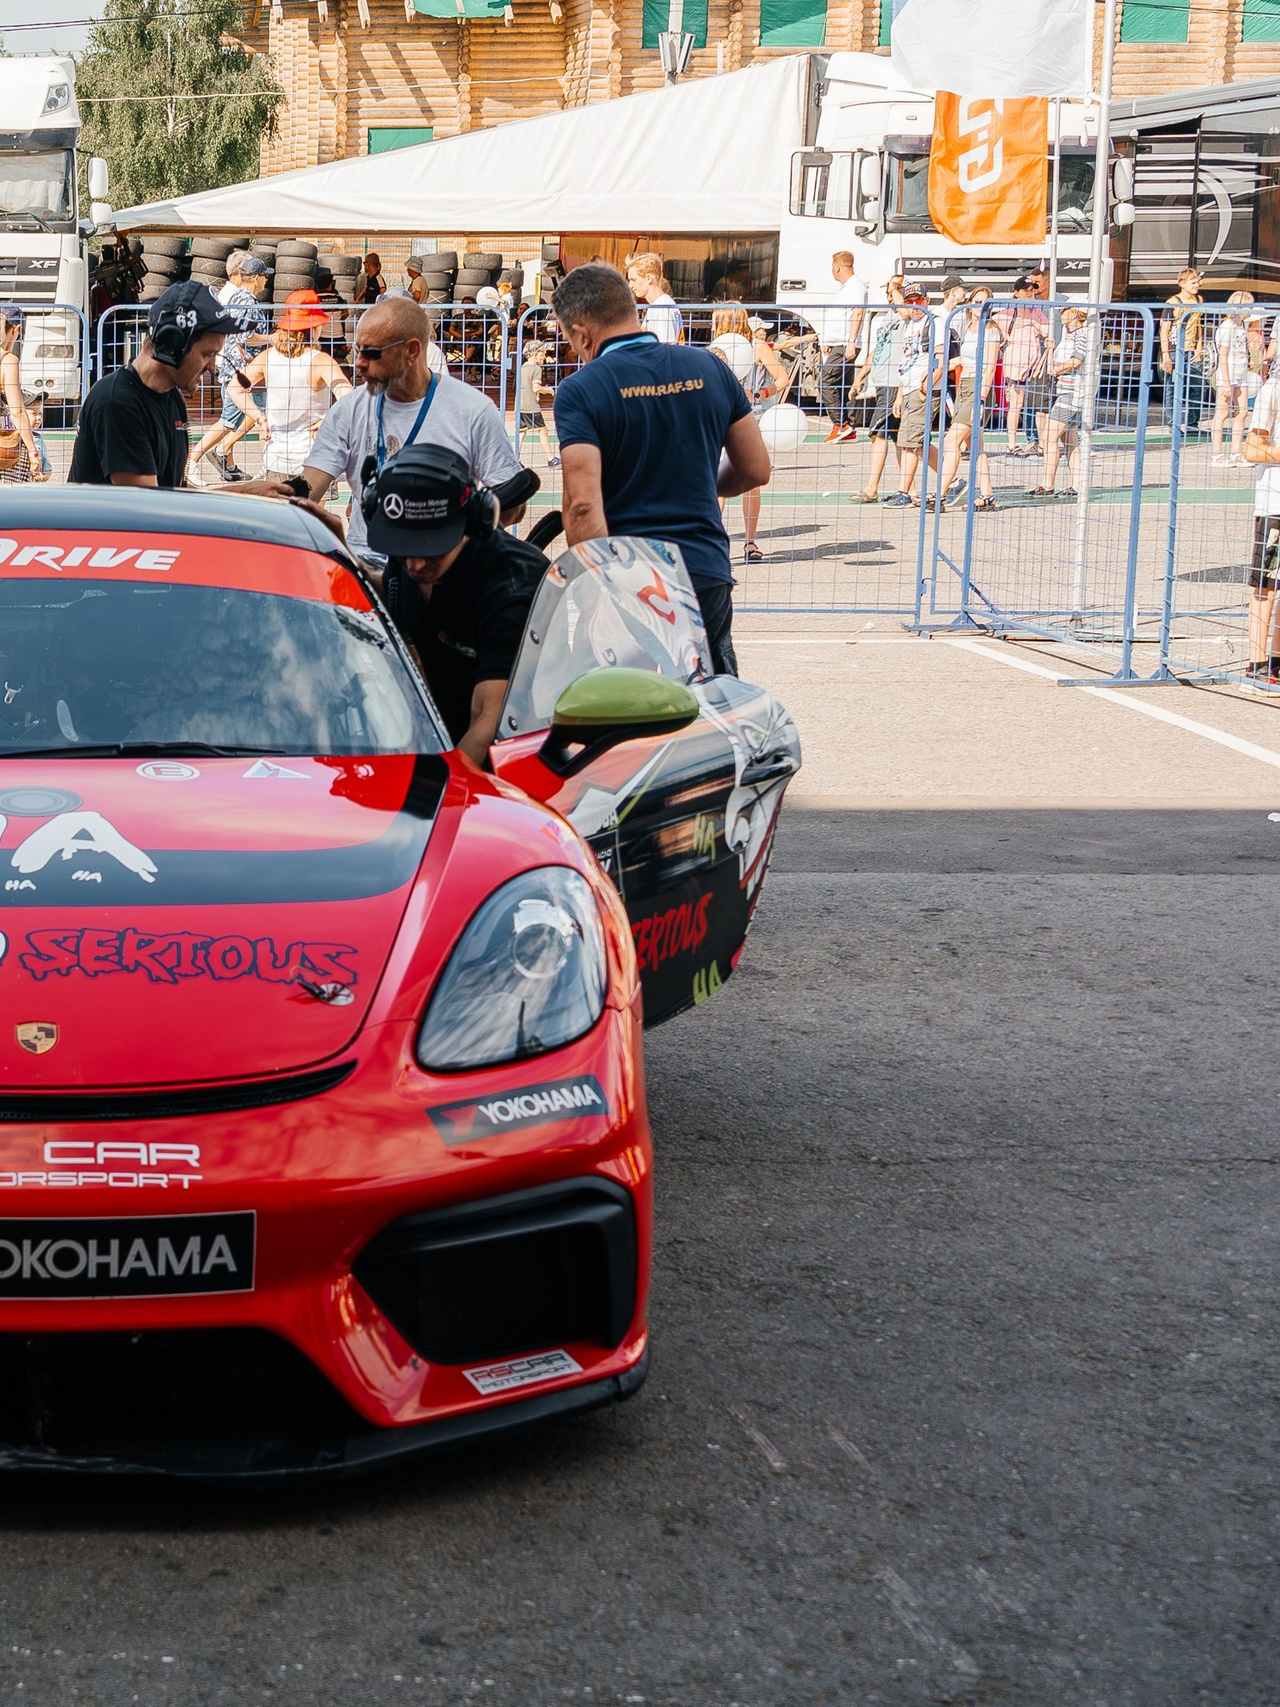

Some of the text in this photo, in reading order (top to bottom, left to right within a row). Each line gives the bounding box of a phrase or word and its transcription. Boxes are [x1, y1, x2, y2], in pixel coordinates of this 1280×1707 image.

[28, 260, 58, 269] XF
[905, 260, 945, 269] DAF
[1063, 261, 1092, 270] XF
[175, 309, 198, 329] 63
[620, 378, 704, 399] WWW.RAF.SU
[4, 878, 37, 891] HA
[71, 869, 102, 883] HA
[19, 927, 358, 986] SERIOUS
[477, 1083, 603, 1125] YOKOHAMA
[470, 1352, 567, 1382] RSCAR
